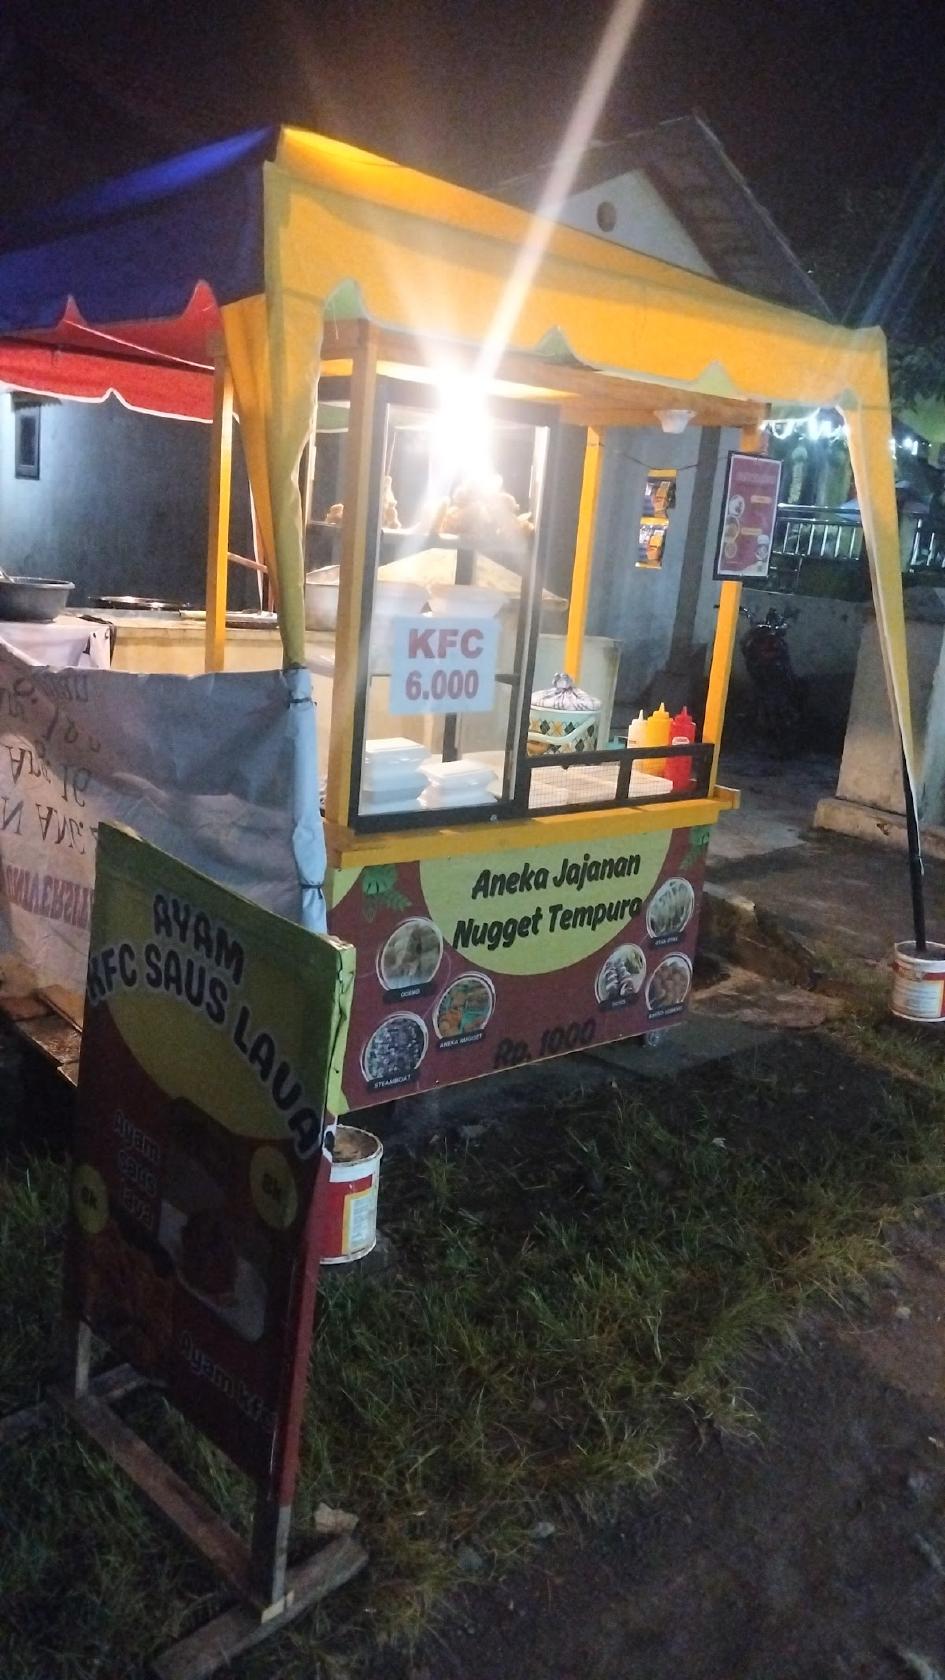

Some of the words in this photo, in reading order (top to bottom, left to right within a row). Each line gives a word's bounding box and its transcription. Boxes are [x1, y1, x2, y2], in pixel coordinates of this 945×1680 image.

[408, 628, 484, 659] KFC
[405, 669, 479, 701] 6.000
[471, 862, 550, 899] Aneka
[552, 853, 641, 891] Jajanan
[153, 893, 244, 986] AYAM
[452, 906, 544, 951] Nugget
[87, 943, 137, 1001] KFC
[144, 943, 228, 1024] SAUS
[493, 1037, 532, 1069] Rp.
[538, 1017, 596, 1056] 1000
[374, 1074, 411, 1090] STEAMBOAT
